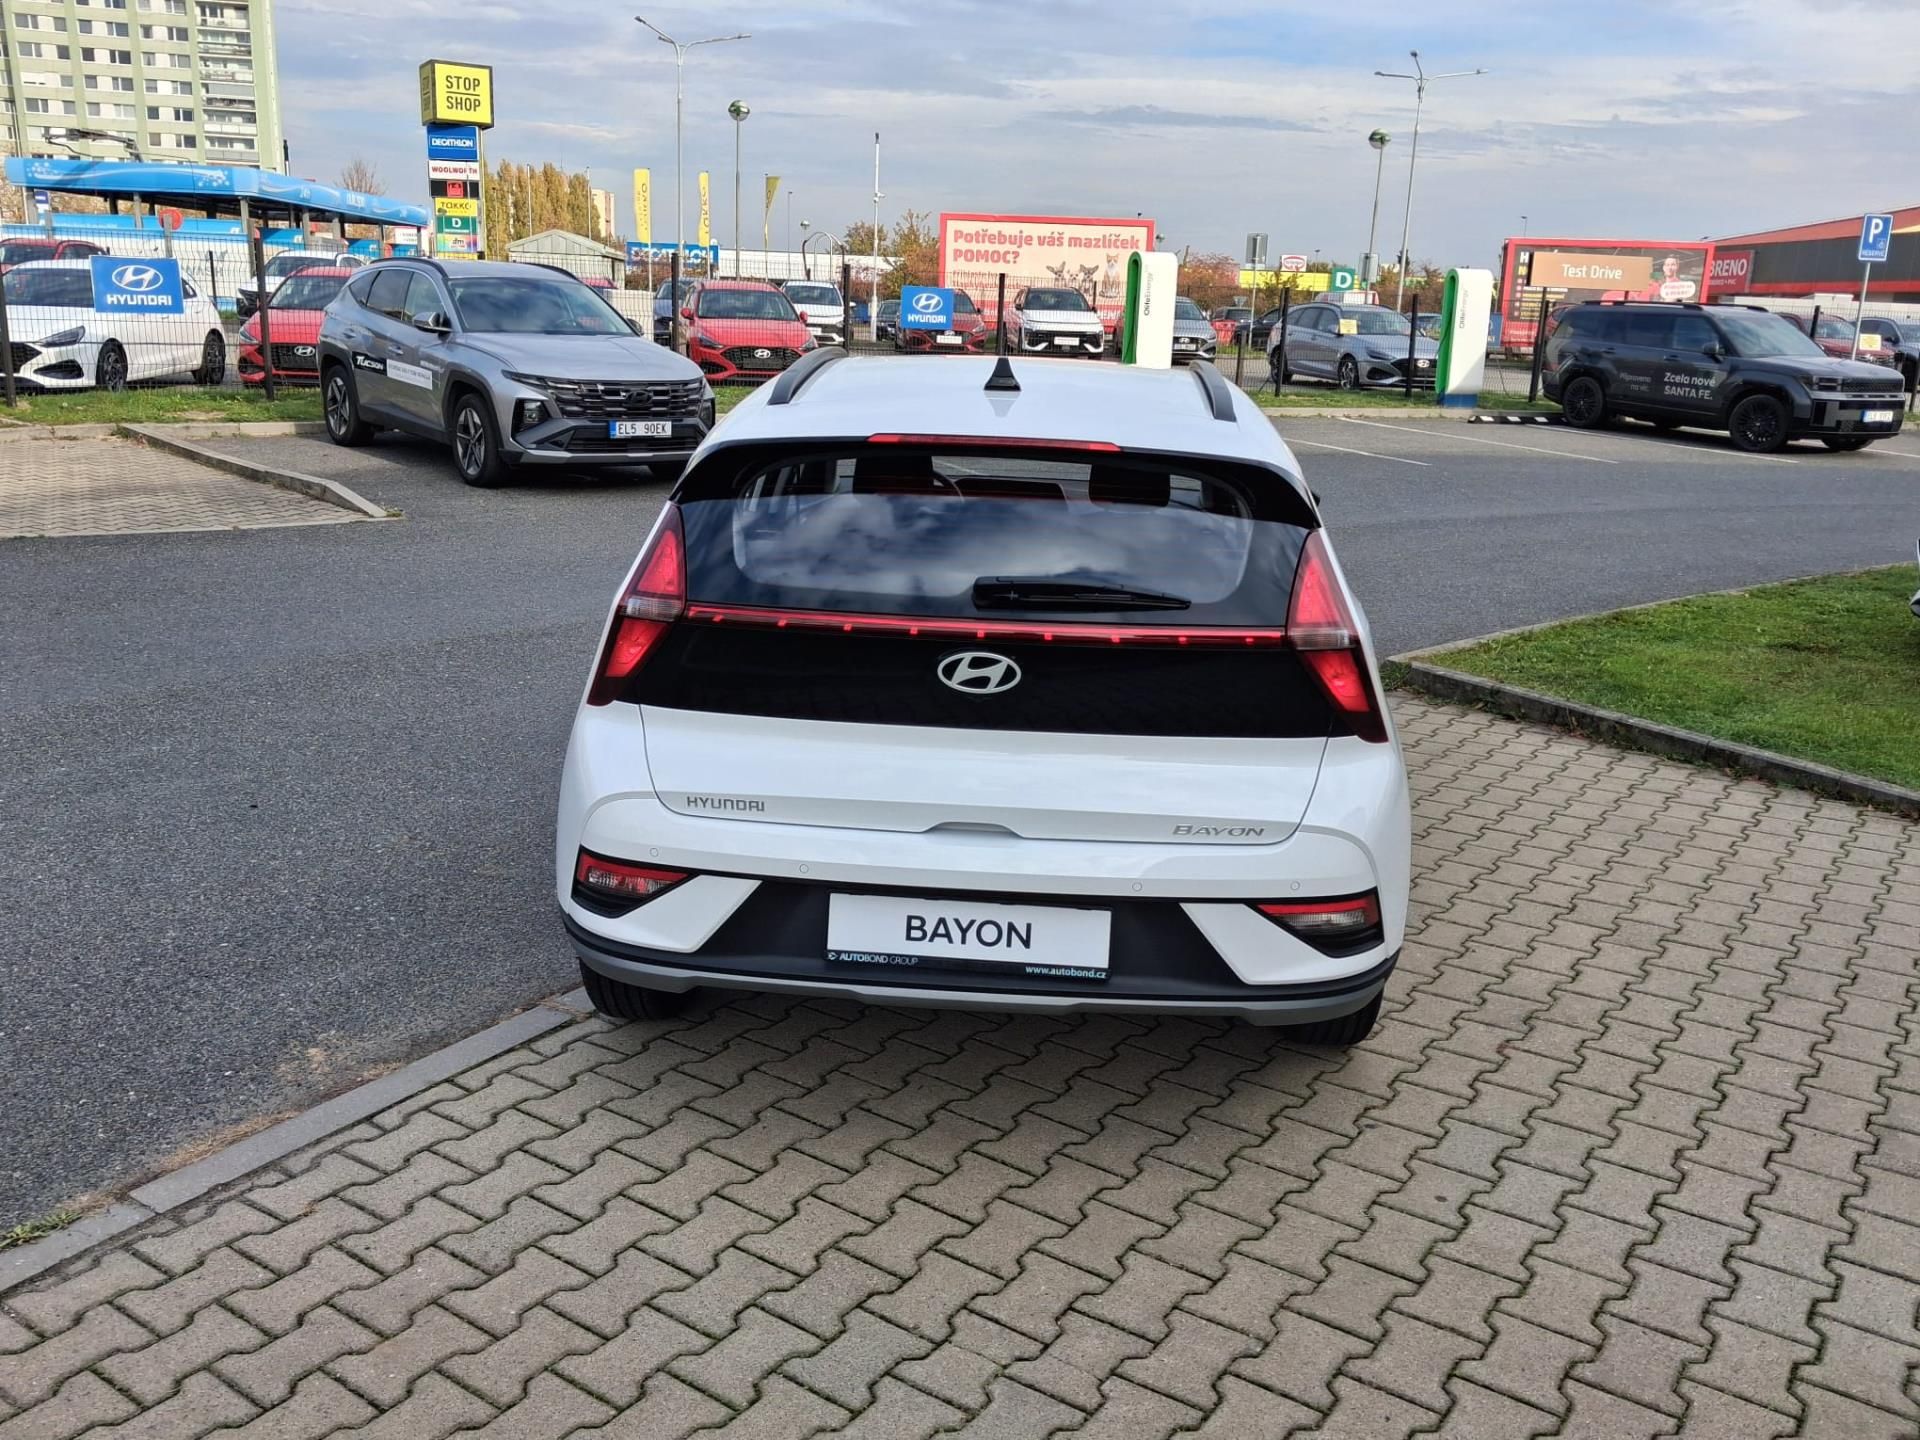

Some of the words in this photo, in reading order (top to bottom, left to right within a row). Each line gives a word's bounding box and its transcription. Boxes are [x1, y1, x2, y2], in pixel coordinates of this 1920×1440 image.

[446, 75, 481, 92] STOP
[446, 96, 481, 112] SHOP
[431, 137, 473, 147] DECATHLON
[451, 218, 462, 228] D
[1868, 218, 1884, 243] P
[953, 229, 1034, 249] Potřebuje
[1037, 231, 1065, 247] váš
[1068, 233, 1140, 250] mazlíček
[953, 249, 1020, 264] POMOC?
[1562, 264, 1587, 278] Test
[1590, 265, 1623, 279] Drive
[1335, 271, 1353, 288] D
[107, 294, 172, 306] HYUNDAI
[907, 314, 946, 324] HYUNDAI
[1663, 372, 1689, 384] Zcela
[1691, 375, 1716, 387] nové
[1663, 386, 1696, 398] SANTA
[1698, 389, 1713, 400] FE.
[618, 423, 637, 435] EL5
[644, 423, 667, 434] 90EK
[686, 795, 765, 812] HYUNDAI
[1172, 823, 1265, 837] BAYON
[905, 914, 1032, 949] BAYON
[839, 952, 888, 964] AUTOBOND
[889, 955, 919, 966] GROUP
[1025, 966, 1106, 979] www.autobond.cz
